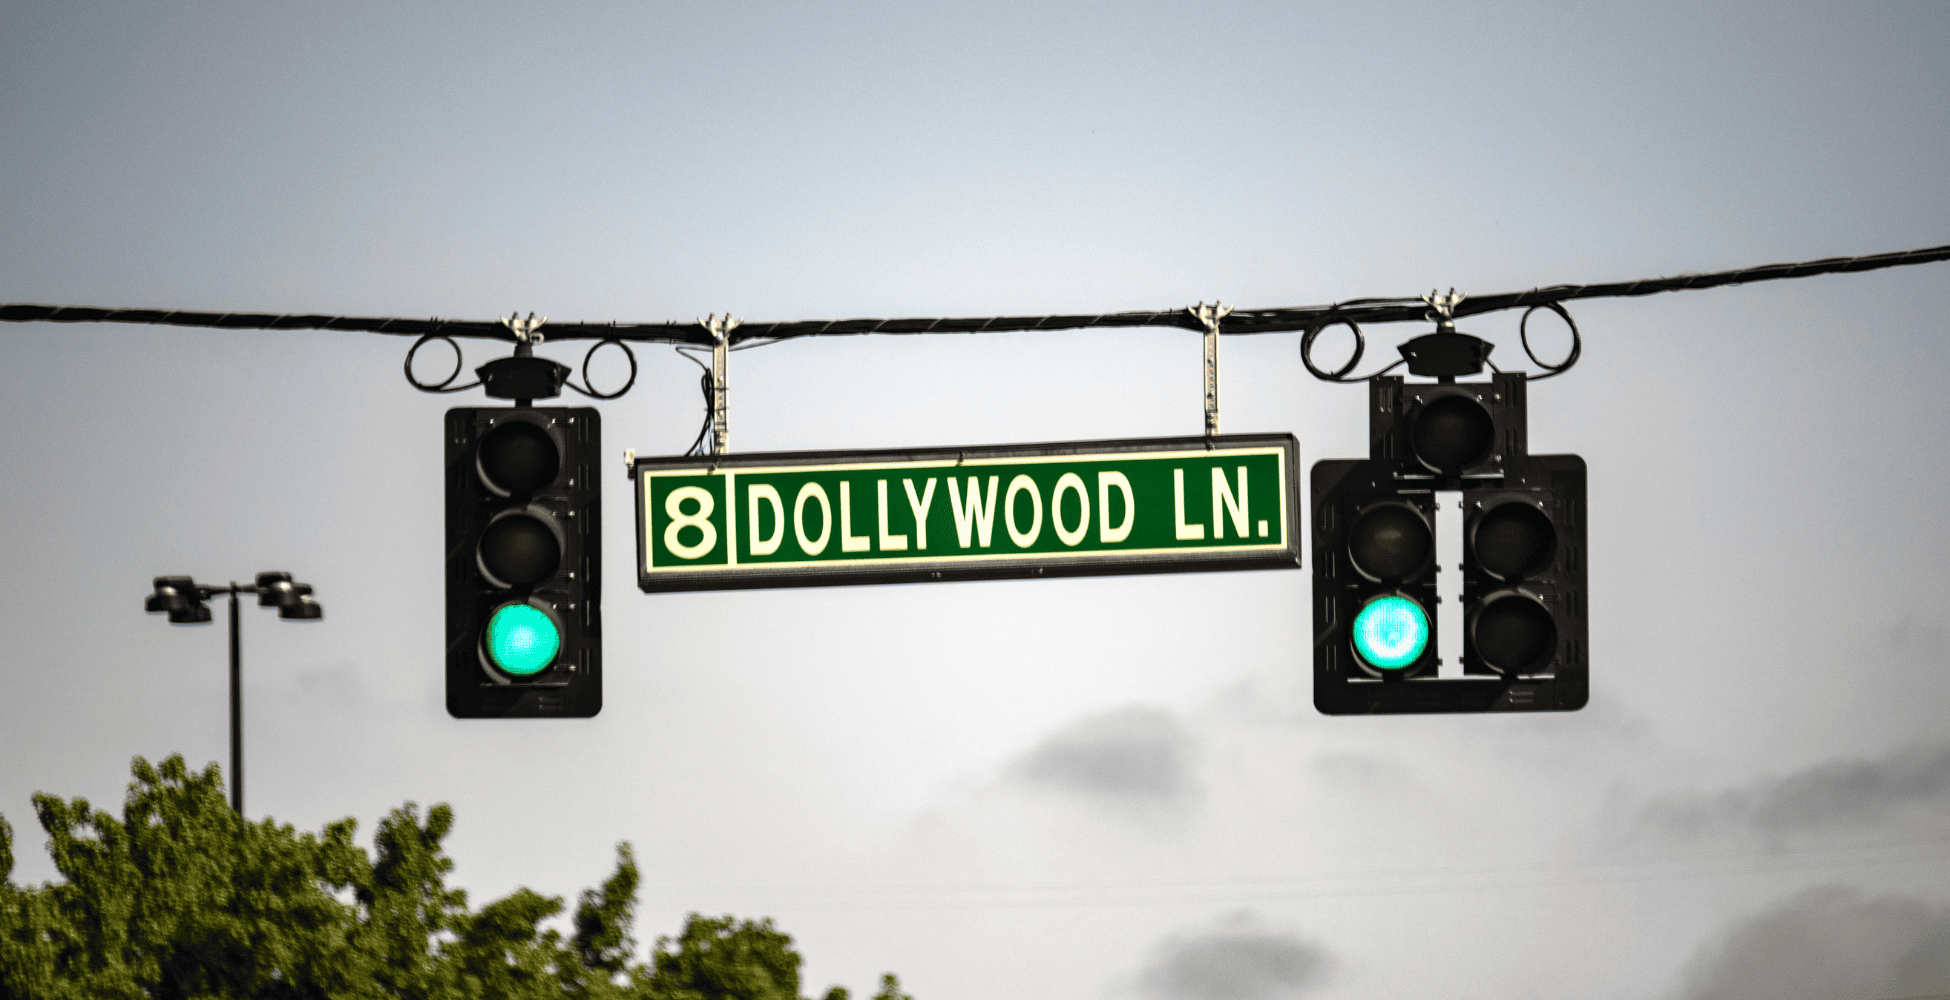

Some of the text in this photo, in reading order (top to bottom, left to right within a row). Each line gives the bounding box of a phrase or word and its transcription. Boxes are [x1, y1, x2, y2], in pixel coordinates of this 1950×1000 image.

[664, 466, 1269, 560] 8 DOLLYWOOD LN.
